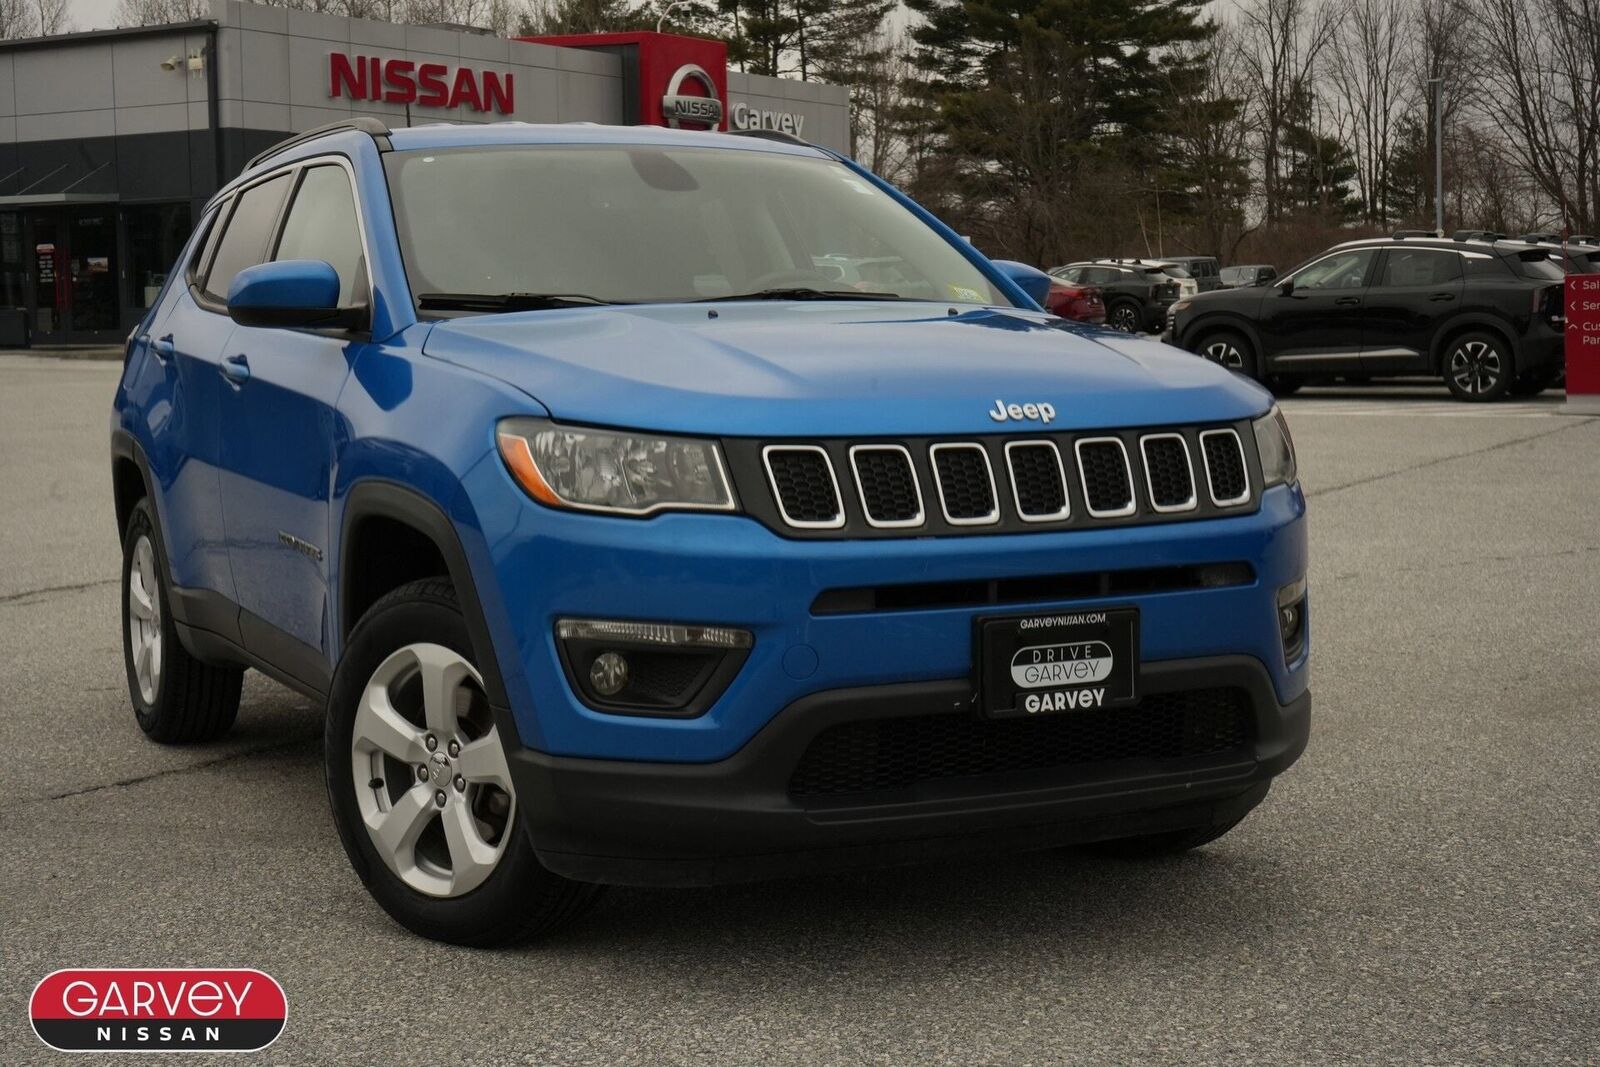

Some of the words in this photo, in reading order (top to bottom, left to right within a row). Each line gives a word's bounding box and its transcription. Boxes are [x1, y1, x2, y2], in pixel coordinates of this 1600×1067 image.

[330, 52, 514, 114] NISSAN
[733, 102, 805, 137] Garvey
[989, 399, 1056, 424] Jeep
[1032, 645, 1092, 663] DRIVE
